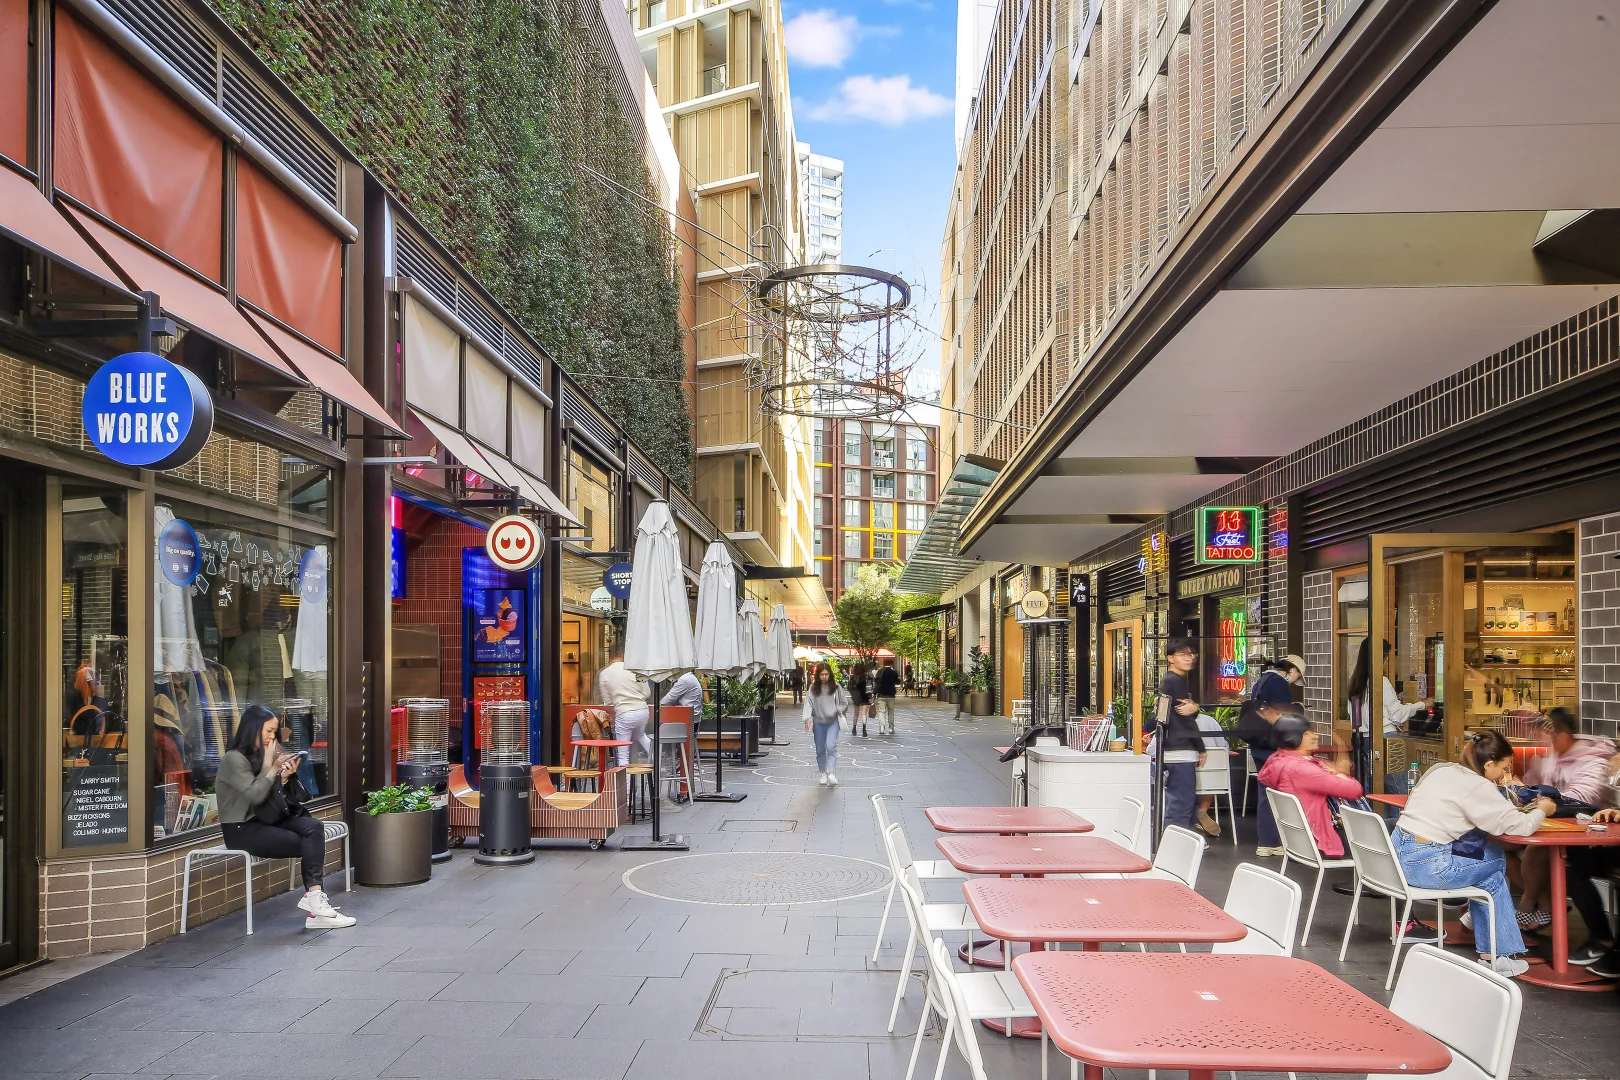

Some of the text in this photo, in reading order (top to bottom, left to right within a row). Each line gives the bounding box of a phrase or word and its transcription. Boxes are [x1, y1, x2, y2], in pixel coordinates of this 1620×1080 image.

[109, 372, 167, 404] BLUE
[97, 411, 179, 444] WORKS
[1219, 510, 1241, 532] 13
[1214, 532, 1245, 546] Feet
[1205, 547, 1255, 559] TATTOO
[1181, 568, 1240, 597] 13 FEET TATTOO
